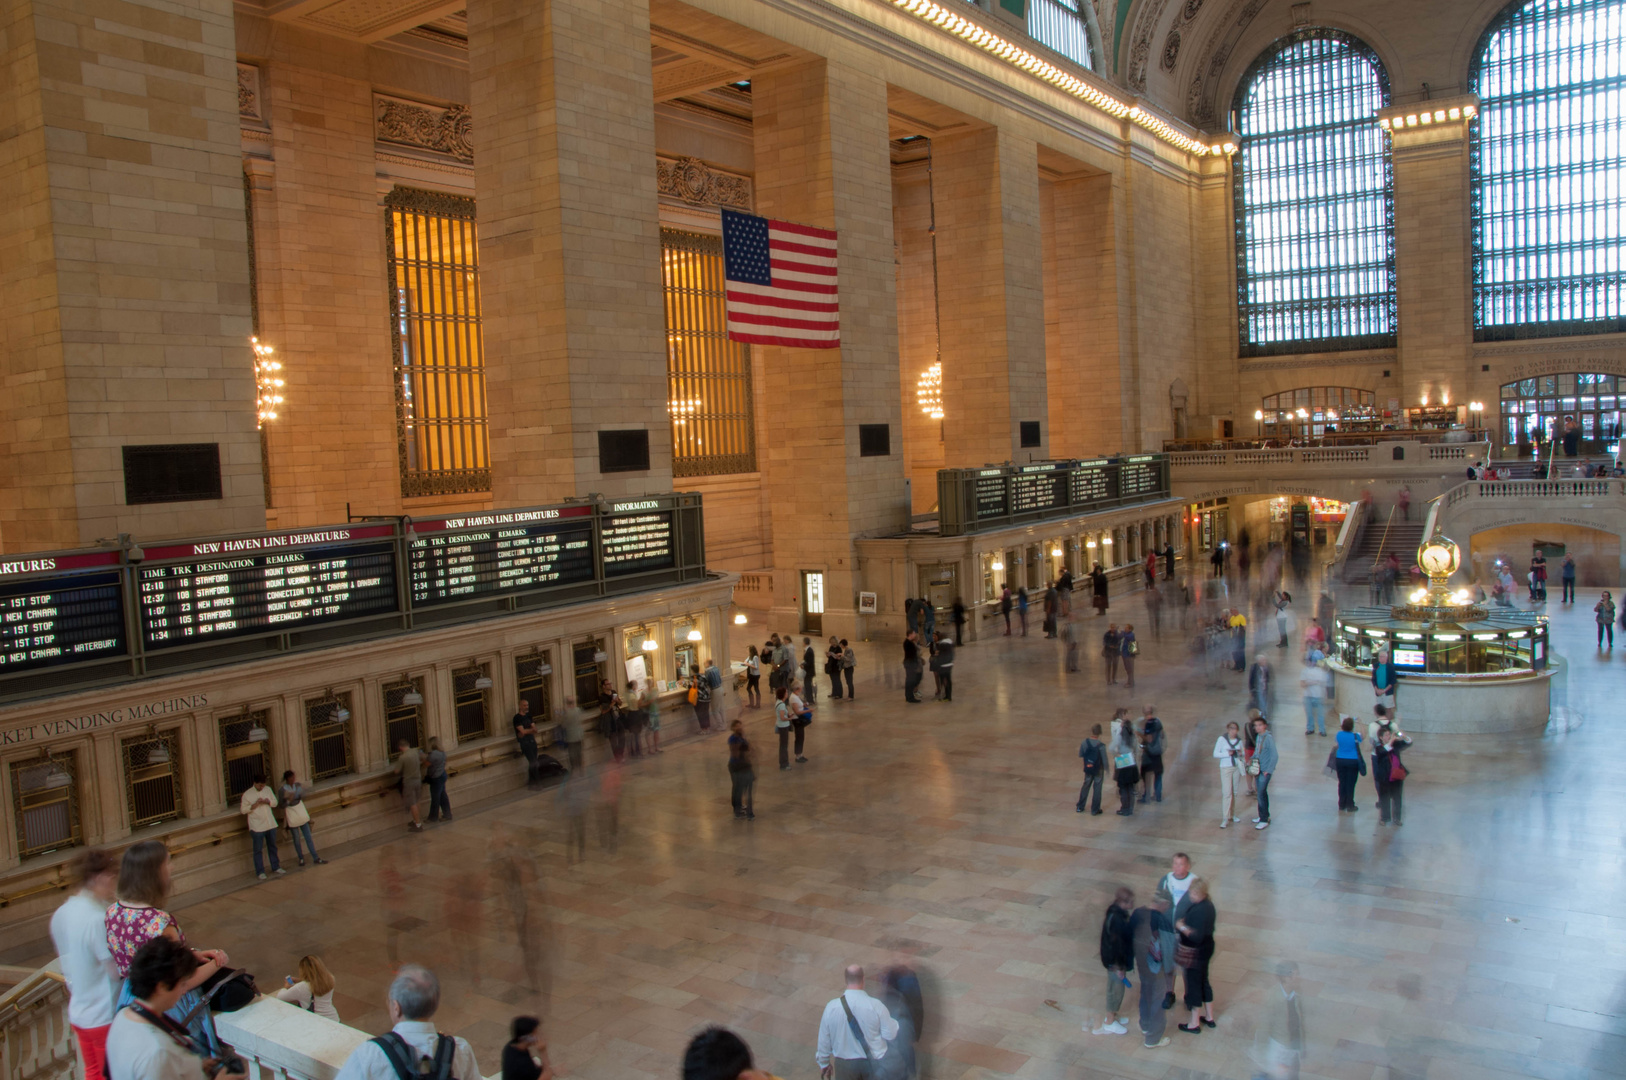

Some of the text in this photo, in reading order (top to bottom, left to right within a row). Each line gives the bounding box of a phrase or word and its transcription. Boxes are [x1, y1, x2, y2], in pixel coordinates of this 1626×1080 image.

[614, 500, 658, 512] INFORMATION
[446, 510, 559, 528] NEW HAVEN LINE DEPARTURES
[194, 530, 350, 554] NEW HAVEN LINE DEPARTURES
[412, 540, 427, 548] IME
[449, 533, 490, 544] DESTINATION
[498, 529, 526, 538] REMARKS
[447, 546, 471, 554] STAMFORD
[498, 548, 525, 558] CONNECTION
[0, 558, 56, 574] RTURES
[142, 553, 304, 578] TIME TRK DESTINATION REMARKS
[449, 565, 472, 574] STAMFORD
[142, 582, 164, 592] 12:10
[180, 579, 188, 587] 16
[196, 574, 228, 585] STAMFORD
[265, 567, 284, 576] MOUNT
[287, 564, 309, 574] VERNON
[319, 562, 330, 570] 1ST
[332, 560, 346, 569] STOP
[414, 582, 427, 590] 2:34
[461, 575, 476, 583] HAVEN
[499, 568, 524, 578] GREENWICH
[143, 594, 164, 604] 12:37
[177, 591, 190, 600] 108
[196, 586, 230, 597] STAMFORD
[266, 578, 285, 588] MOUNT
[288, 576, 310, 586] VERNON
[320, 573, 330, 581] 1ST
[333, 571, 347, 580] STOP
[451, 586, 474, 595] STAMFORD
[516, 577, 532, 585] VERNON
[11, 598, 26, 608] 1ST
[30, 595, 51, 605] STOP
[149, 606, 166, 616] 1:07
[182, 603, 191, 612] 23
[197, 600, 211, 609] NEW
[214, 597, 234, 607] HAVEN
[267, 588, 304, 600] CONNECTION
[307, 586, 314, 594] TO
[317, 585, 324, 593] N.
[327, 582, 348, 592] CANAAN
[357, 578, 380, 587] DANBURY
[6, 608, 57, 622] NEW CANAAN
[150, 619, 167, 628] 1:10
[180, 615, 192, 624] 105
[199, 610, 231, 621] STAMFORD
[268, 602, 287, 612] MOUNT
[290, 599, 312, 609] VERNON
[322, 595, 332, 604] 1ST
[335, 593, 349, 602] STOP
[14, 624, 28, 635] 1ST
[33, 622, 54, 632] STOP
[151, 631, 168, 640] 1:34
[184, 627, 193, 636] 19
[200, 624, 213, 633] NEW
[216, 621, 236, 631] HAVEN
[268, 611, 302, 624] GREENWICH
[312, 608, 323, 616] 1ST
[326, 606, 340, 614] STOP
[10, 652, 26, 662] NEW
[30, 647, 61, 659] CANAAN
[74, 639, 116, 653] WATERBURY
[15, 638, 30, 648] 1ST
[34, 635, 55, 646] STOP
[42, 710, 123, 736] VENDING
[128, 694, 208, 720] MACHINES
